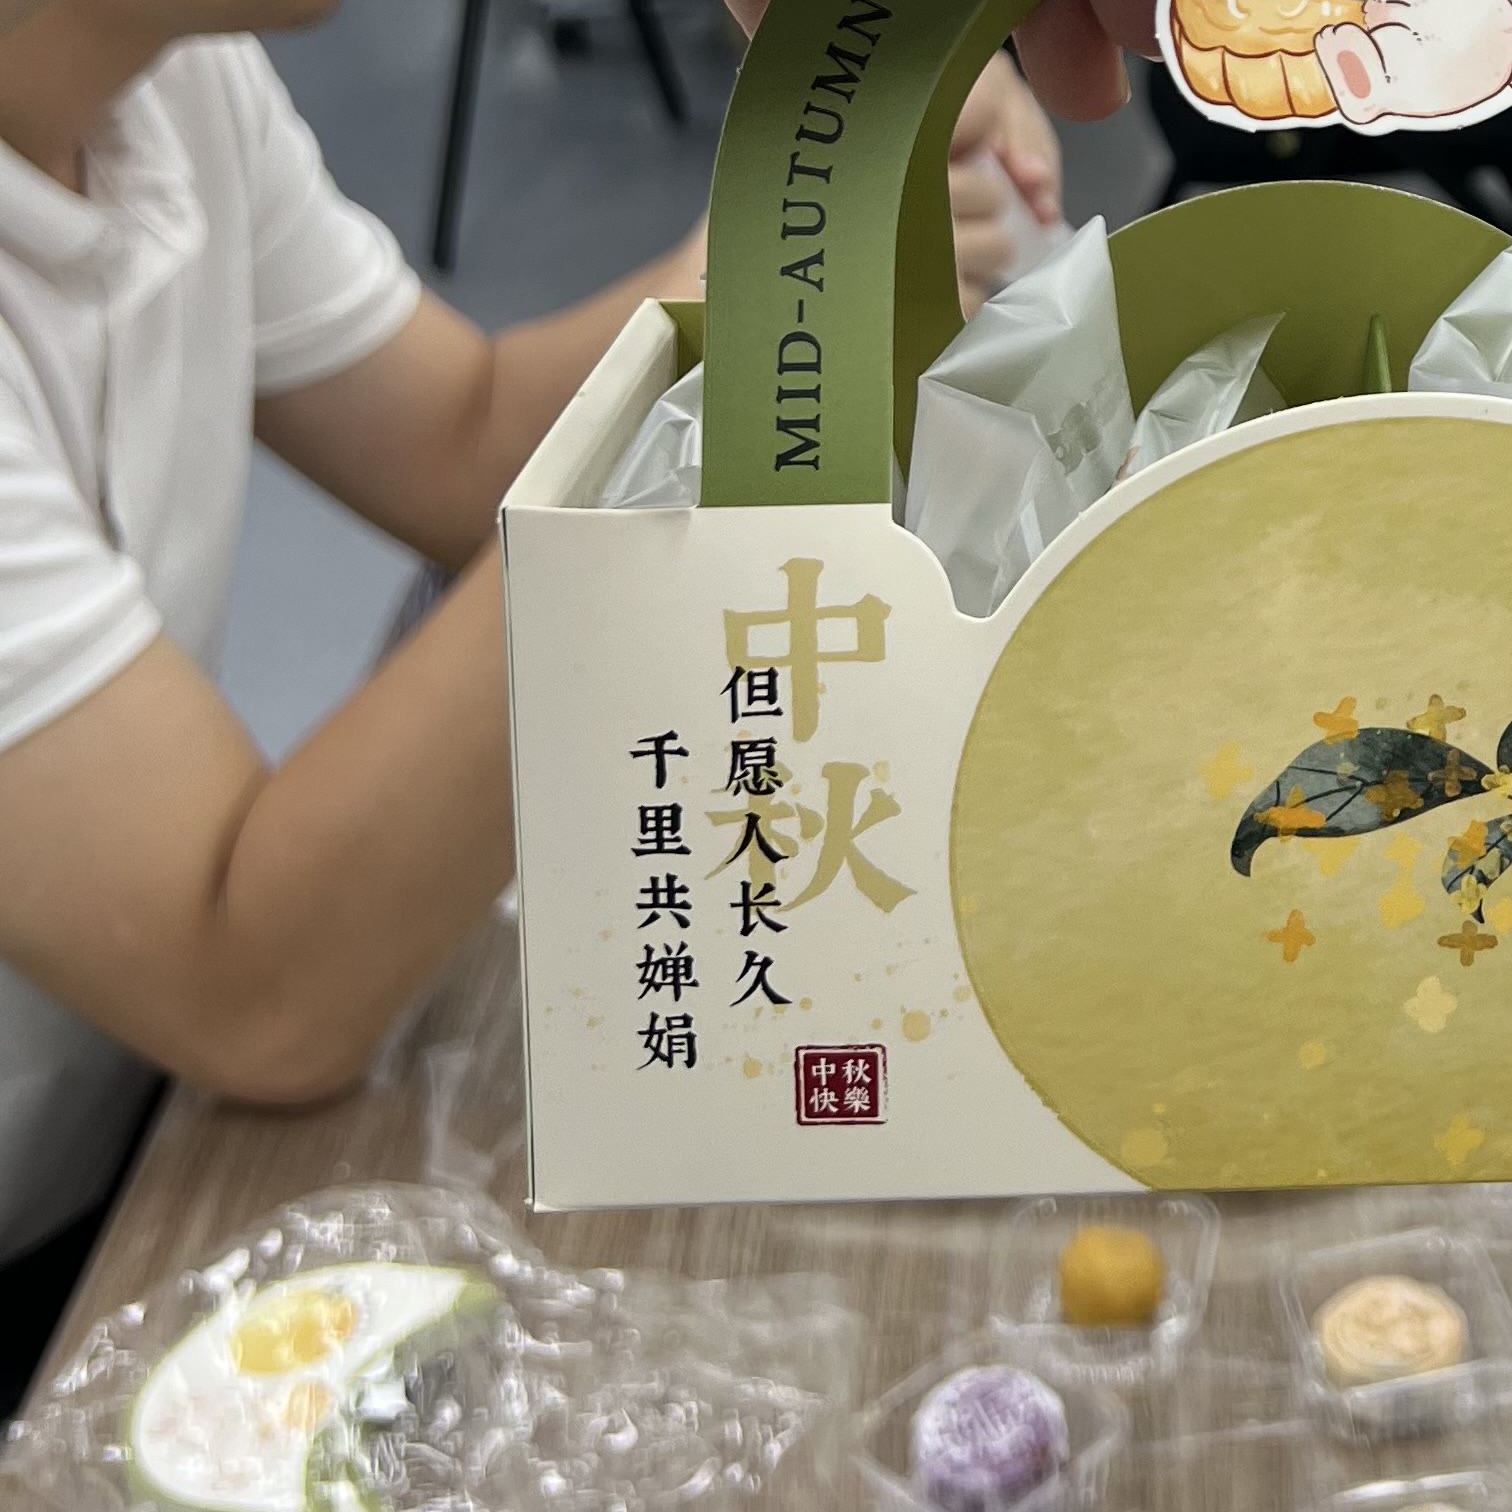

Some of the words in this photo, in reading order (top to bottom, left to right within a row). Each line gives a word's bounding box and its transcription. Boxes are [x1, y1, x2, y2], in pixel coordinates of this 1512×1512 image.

[628, 730, 700, 1070] 千里共婵娟
[704, 557, 918, 913] 中秋
[720, 664, 792, 1008] 但愿人长久
[808, 1086, 872, 1114] 快樂
[811, 1057, 872, 1086] 中秋
